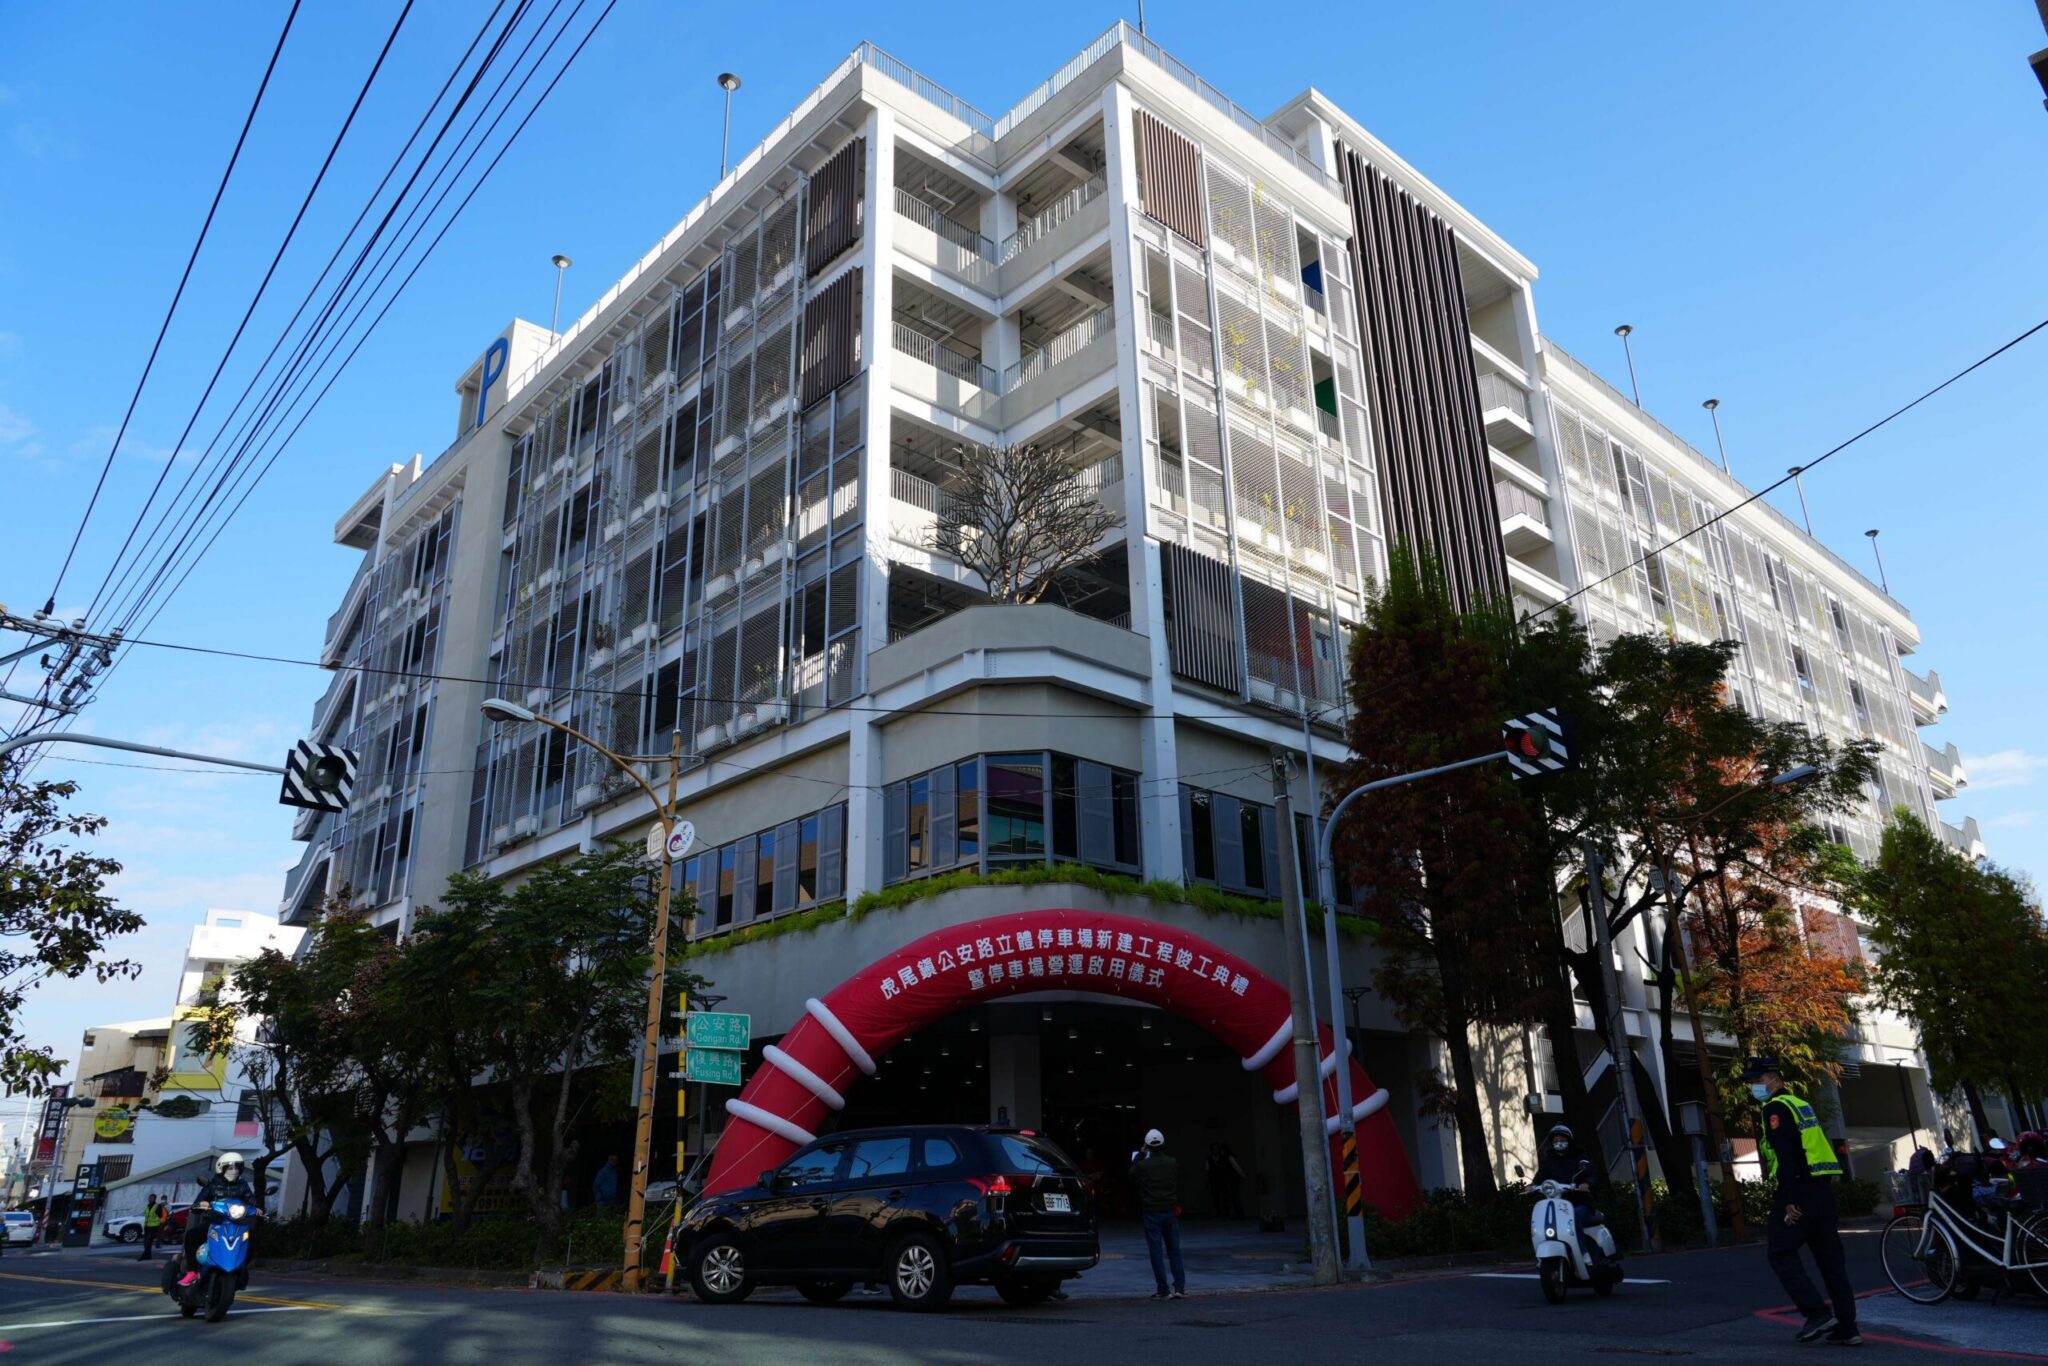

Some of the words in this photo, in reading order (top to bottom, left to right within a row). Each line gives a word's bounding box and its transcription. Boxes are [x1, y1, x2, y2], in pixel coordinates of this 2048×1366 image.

[476, 337, 509, 429] P
[879, 928, 1250, 1000] 虎尾鎮公安路立體停車場新建工程竣工典禮
[967, 954, 1165, 990] 暨停車場營運啟用儀式
[697, 1016, 741, 1032] 公安路
[696, 1033, 728, 1045] Gongan
[729, 1034, 741, 1044] Rd.
[695, 1051, 733, 1067] 復興路
[695, 1067, 721, 1080] Fusing
[722, 1070, 735, 1080] Rd.
[79, 1166, 91, 1177] P
